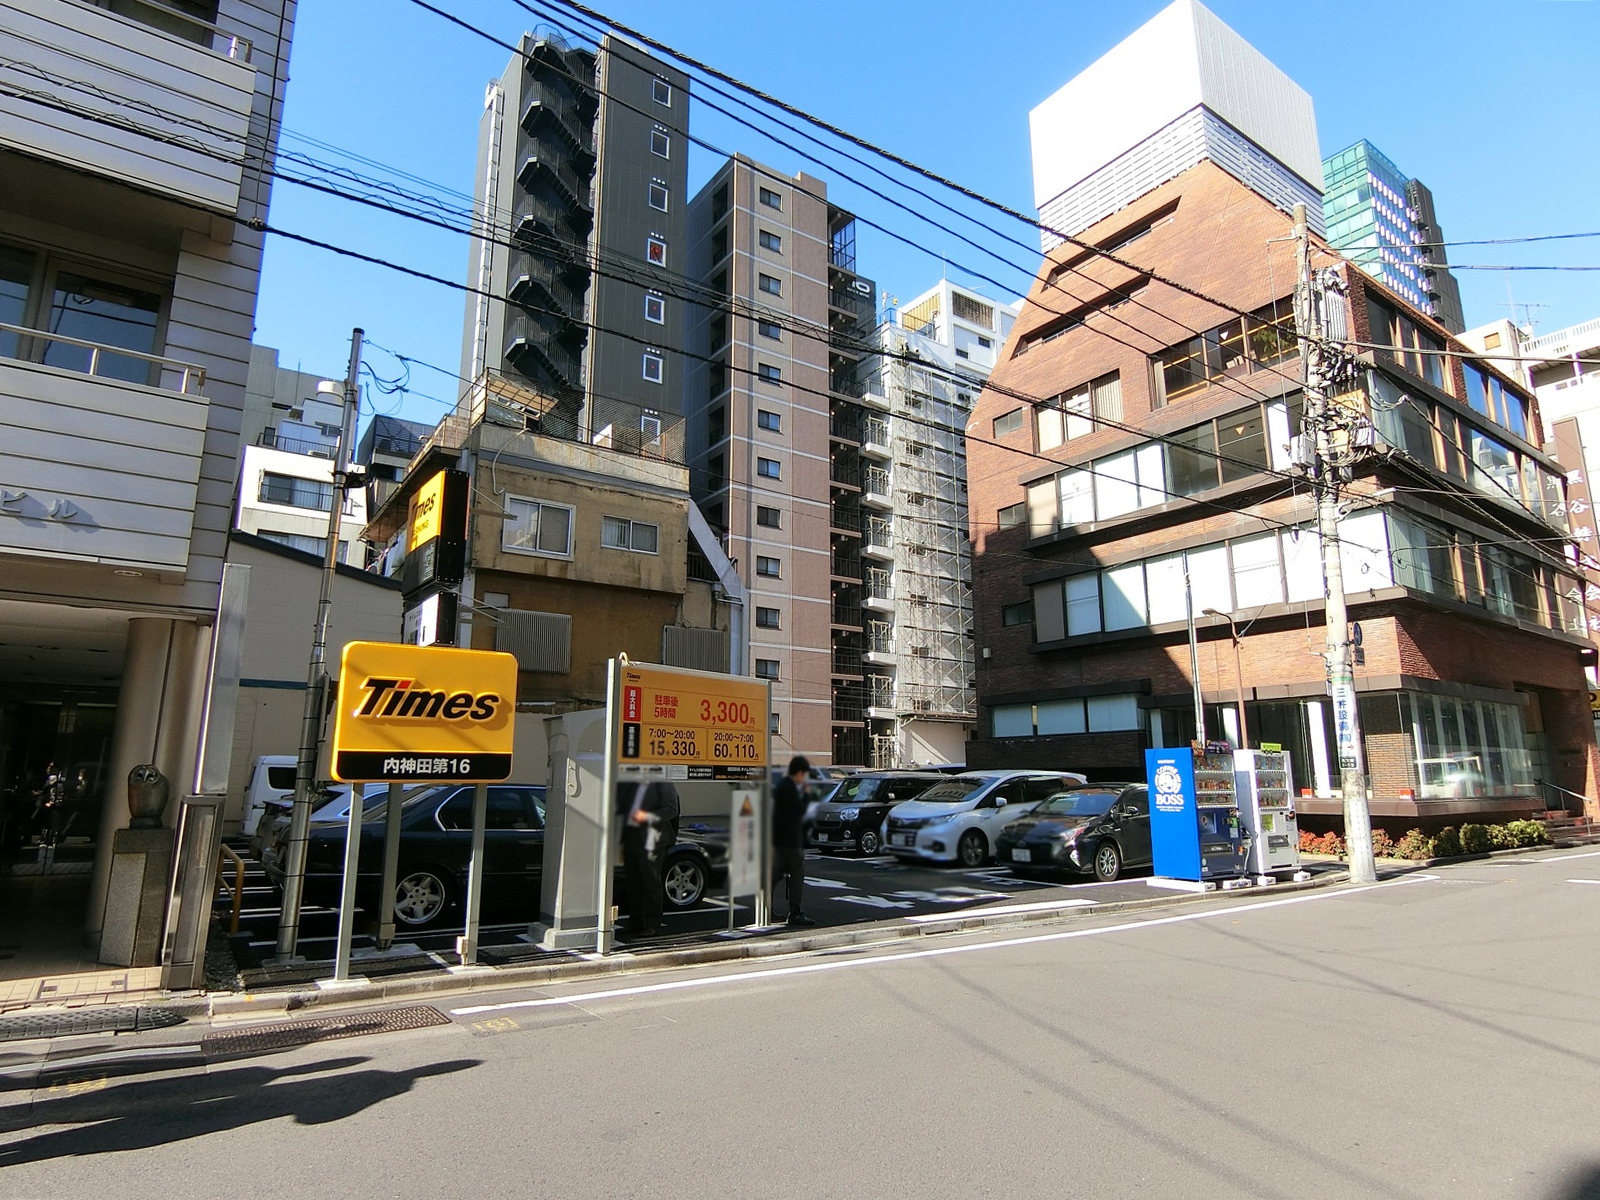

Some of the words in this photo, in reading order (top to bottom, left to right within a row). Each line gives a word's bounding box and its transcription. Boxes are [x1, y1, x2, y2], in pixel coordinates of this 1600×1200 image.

[0, 489, 78, 518] ビル
[359, 678, 499, 720] Times
[654, 694, 679, 707] 駐車後
[654, 707, 676, 719] 5時間
[383, 757, 471, 774] 内神田第16
[1155, 793, 1184, 805] BOSS
